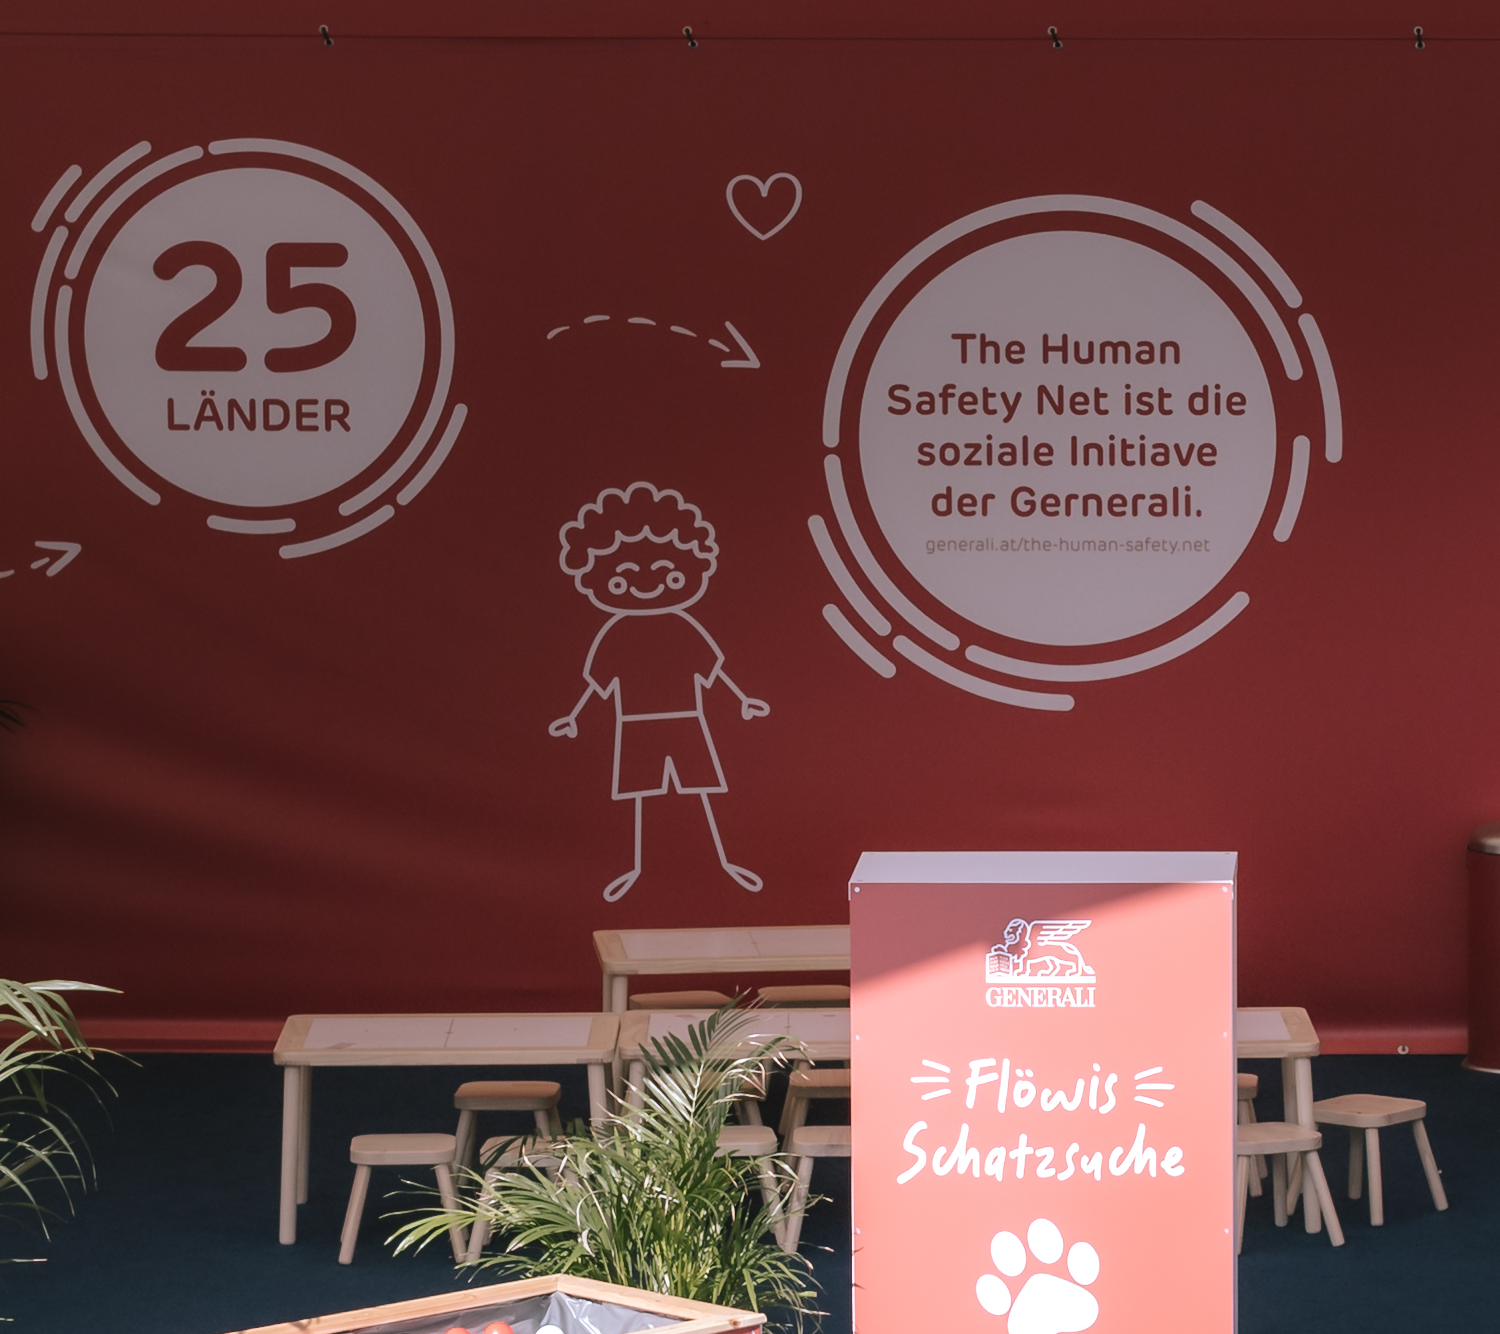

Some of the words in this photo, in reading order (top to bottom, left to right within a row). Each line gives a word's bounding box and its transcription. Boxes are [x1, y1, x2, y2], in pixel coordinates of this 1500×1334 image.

[152, 239, 358, 374] 25
[951, 332, 1027, 366] The
[1041, 332, 1182, 366] Human
[166, 389, 352, 433] LÄNDER
[886, 382, 1023, 424] Safety
[1036, 383, 1110, 417] Net
[1123, 382, 1174, 417] ist
[1186, 383, 1248, 417] die
[916, 434, 1055, 468] soziale
[1070, 434, 1219, 468] Initiave
[930, 485, 997, 519] der
[1010, 485, 1204, 519] Gernerali.
[925, 536, 1212, 556] generali.at/the-human-safety.net
[985, 986, 1097, 1008] GENERALI
[965, 1057, 1119, 1115] Flöwis
[896, 1120, 1186, 1185] Schatzsuche
